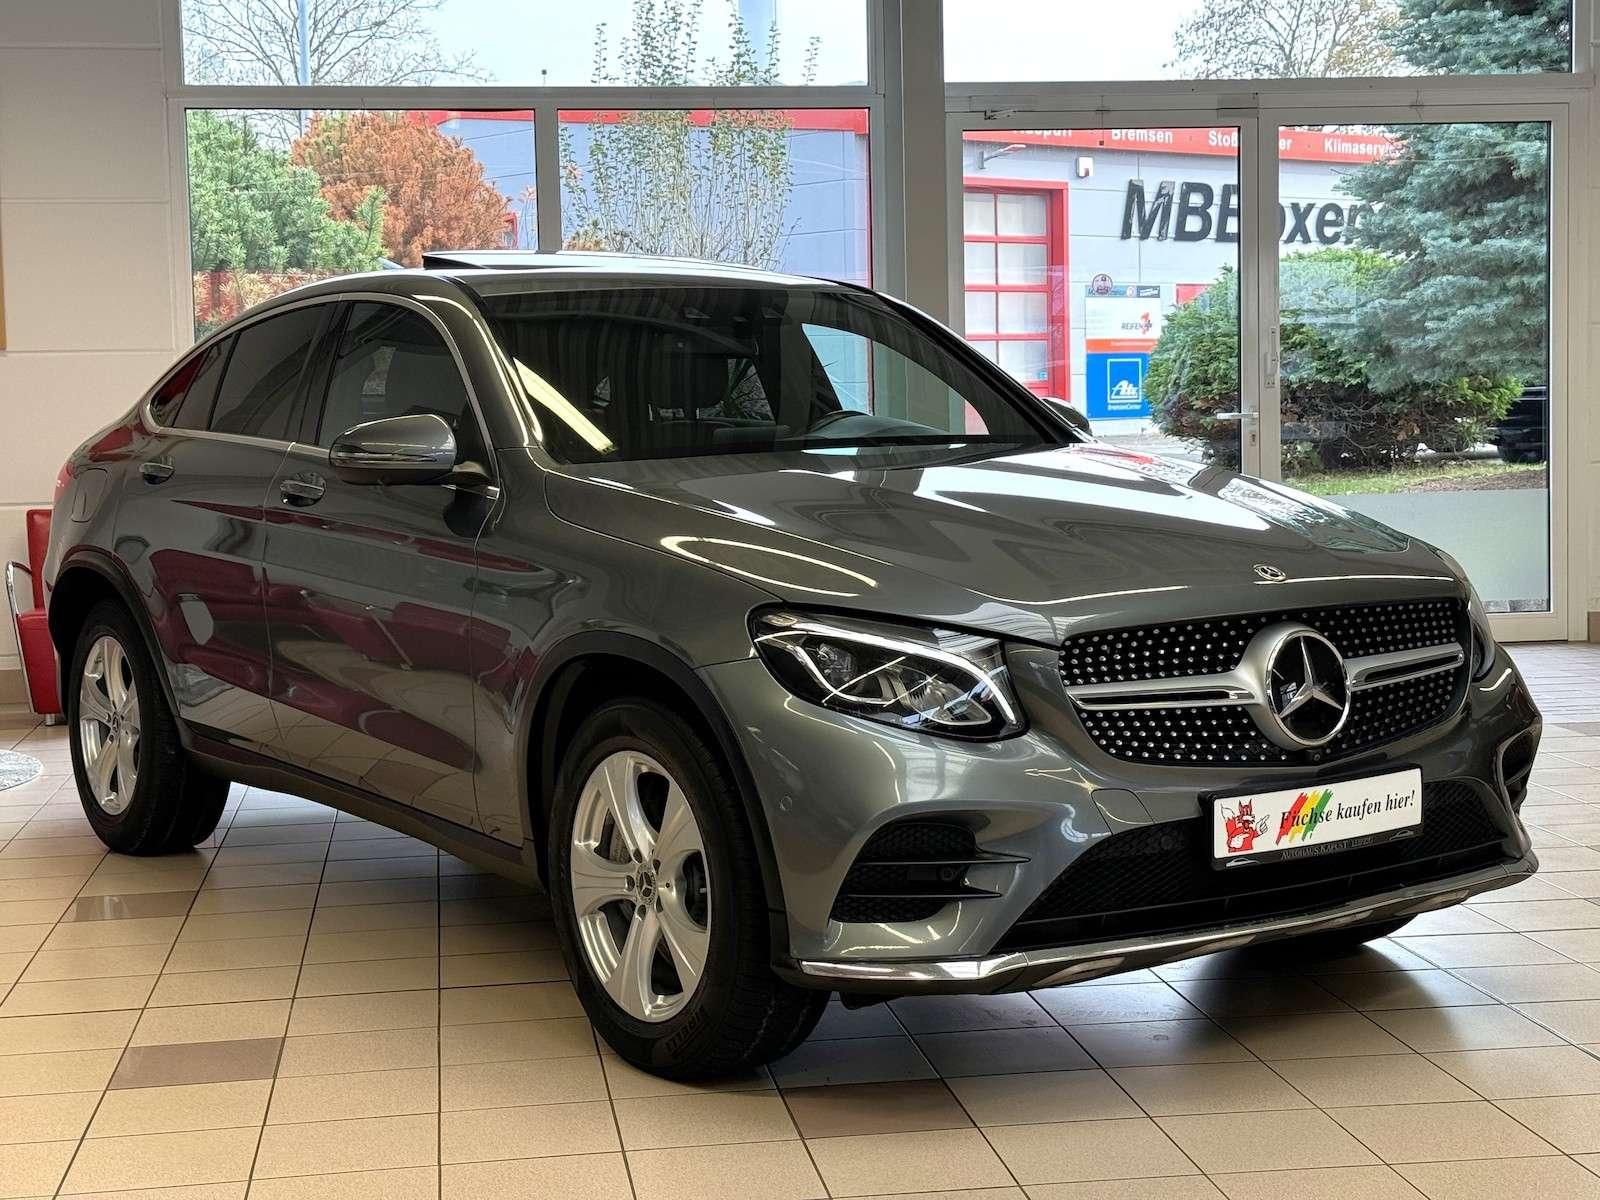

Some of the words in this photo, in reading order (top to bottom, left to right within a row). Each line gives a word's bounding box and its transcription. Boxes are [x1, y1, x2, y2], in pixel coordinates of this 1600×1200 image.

[1111, 129, 1173, 144] Bremsen
[1336, 798, 1382, 821] kaufen
[1385, 789, 1416, 812] hier!
